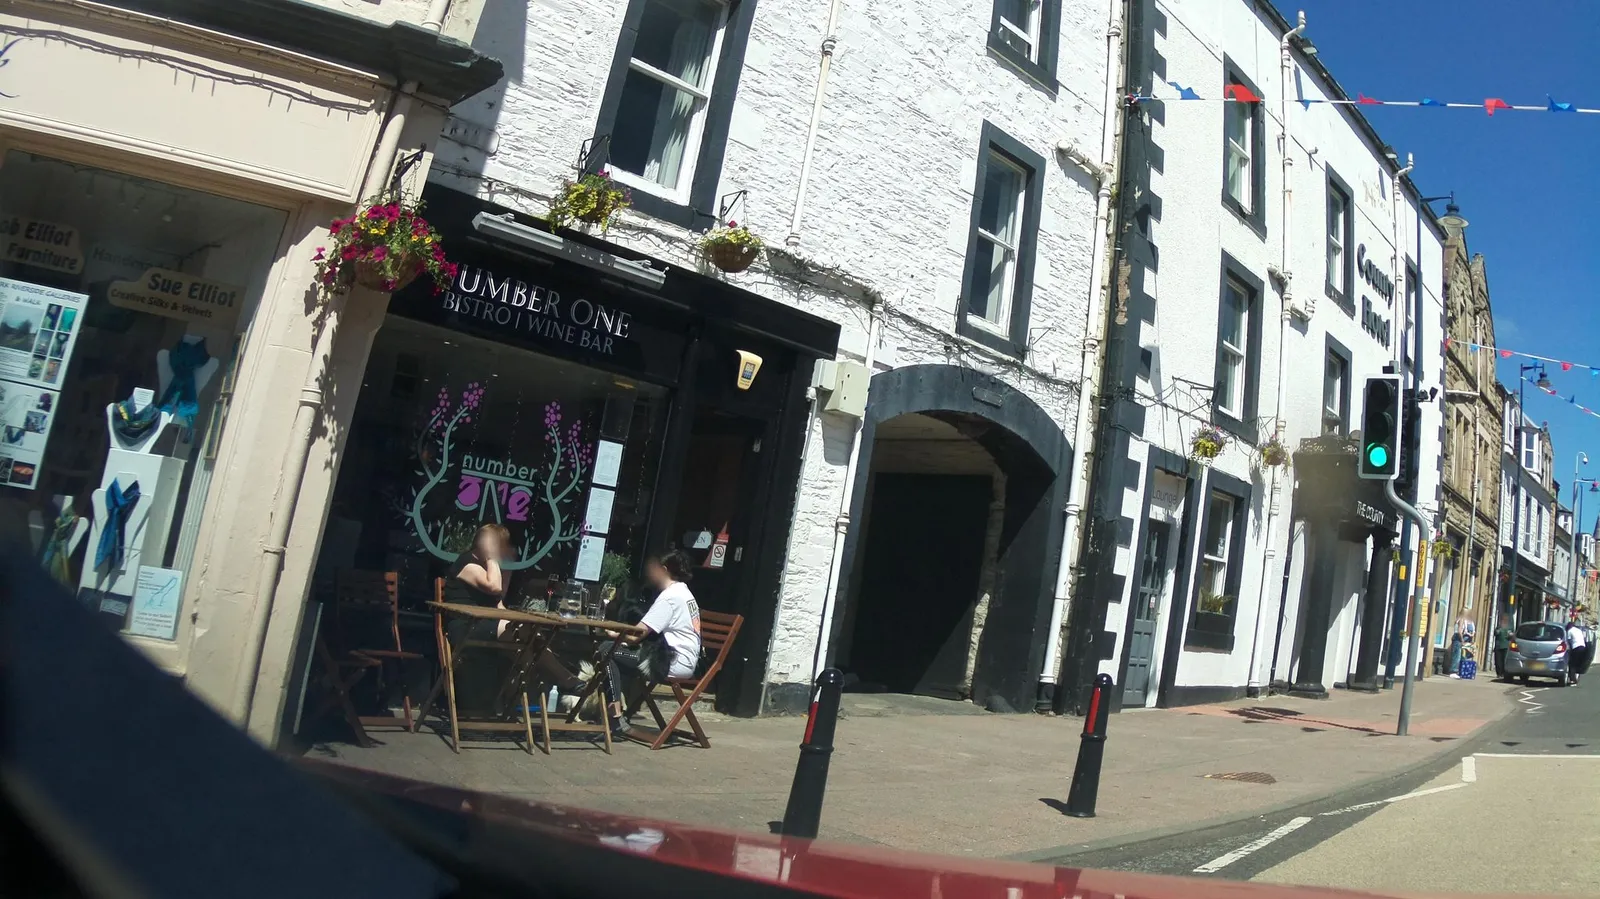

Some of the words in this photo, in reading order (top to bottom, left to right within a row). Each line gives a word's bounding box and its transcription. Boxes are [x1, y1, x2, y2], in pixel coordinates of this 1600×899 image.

[24, 222, 74, 247] Elliot
[7, 242, 78, 270] Furniture
[147, 272, 183, 296] Sue
[187, 281, 237, 308] Elliot
[1357, 243, 1394, 310] County
[442, 291, 512, 325] BISTRO
[528, 313, 576, 344] WINE
[579, 329, 614, 355] BAR
[570, 299, 632, 339] ONE
[1361, 294, 1391, 351] Hotel
[462, 454, 538, 481] number
